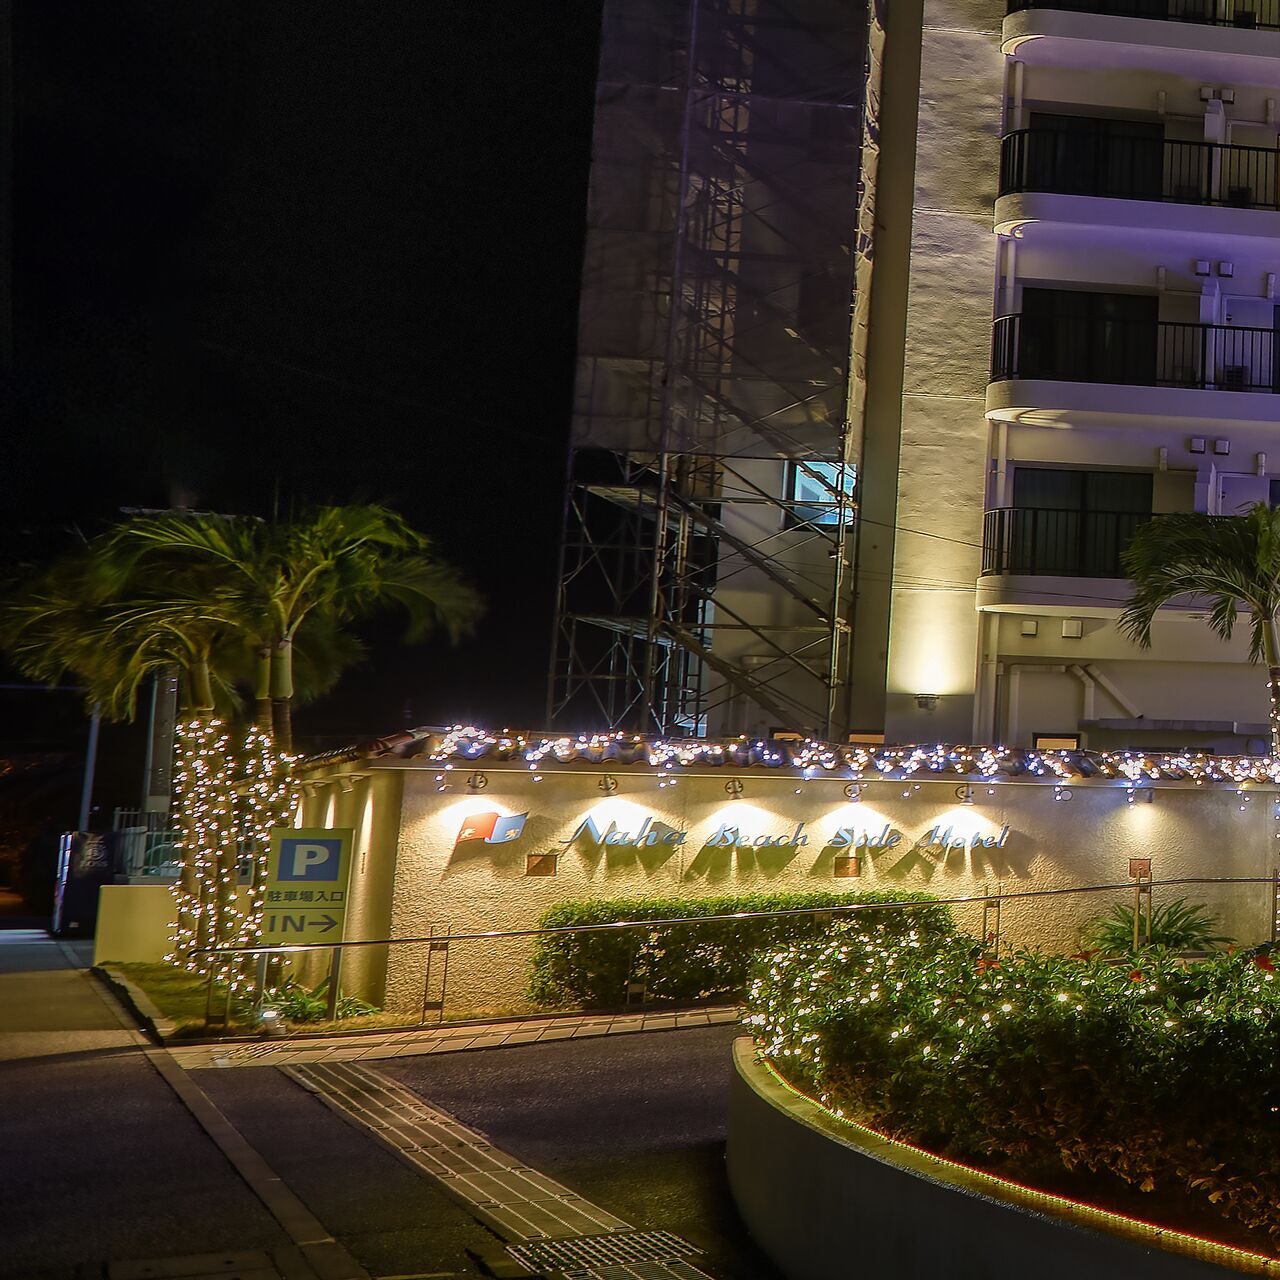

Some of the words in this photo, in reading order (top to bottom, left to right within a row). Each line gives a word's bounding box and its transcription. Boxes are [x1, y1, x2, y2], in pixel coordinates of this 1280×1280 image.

[558, 814, 688, 847] Naha
[705, 822, 808, 848] Beach
[828, 823, 904, 849] Side
[915, 825, 1009, 849] Hotel
[292, 844, 329, 876] P
[267, 890, 344, 902] 駐車場入口
[268, 915, 306, 932] IN
